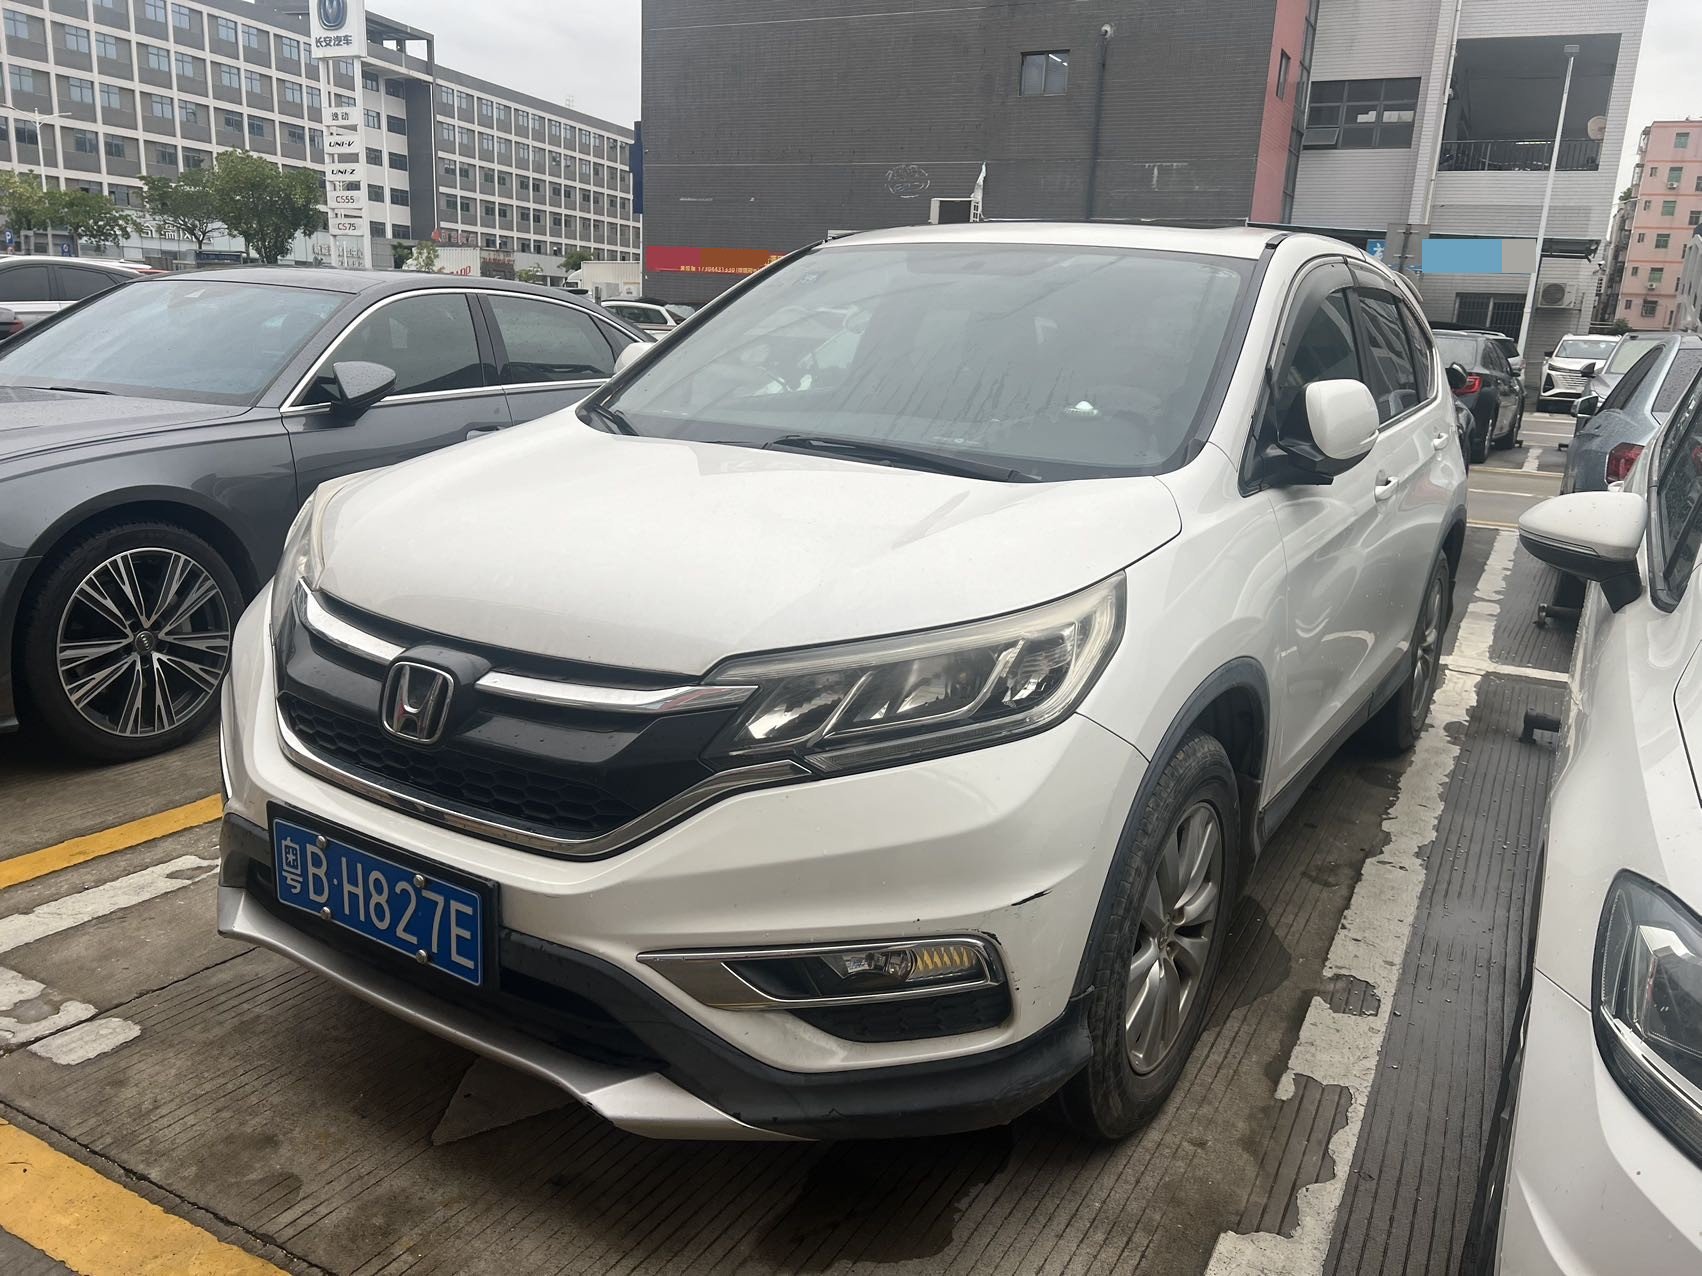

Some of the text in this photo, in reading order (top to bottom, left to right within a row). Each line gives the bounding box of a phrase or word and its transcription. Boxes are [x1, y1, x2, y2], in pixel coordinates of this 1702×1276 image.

[315, 35, 352, 48] 长安汽车
[331, 111, 349, 121] 逸动
[335, 195, 355, 204] CS55
[337, 222, 357, 231] CS75
